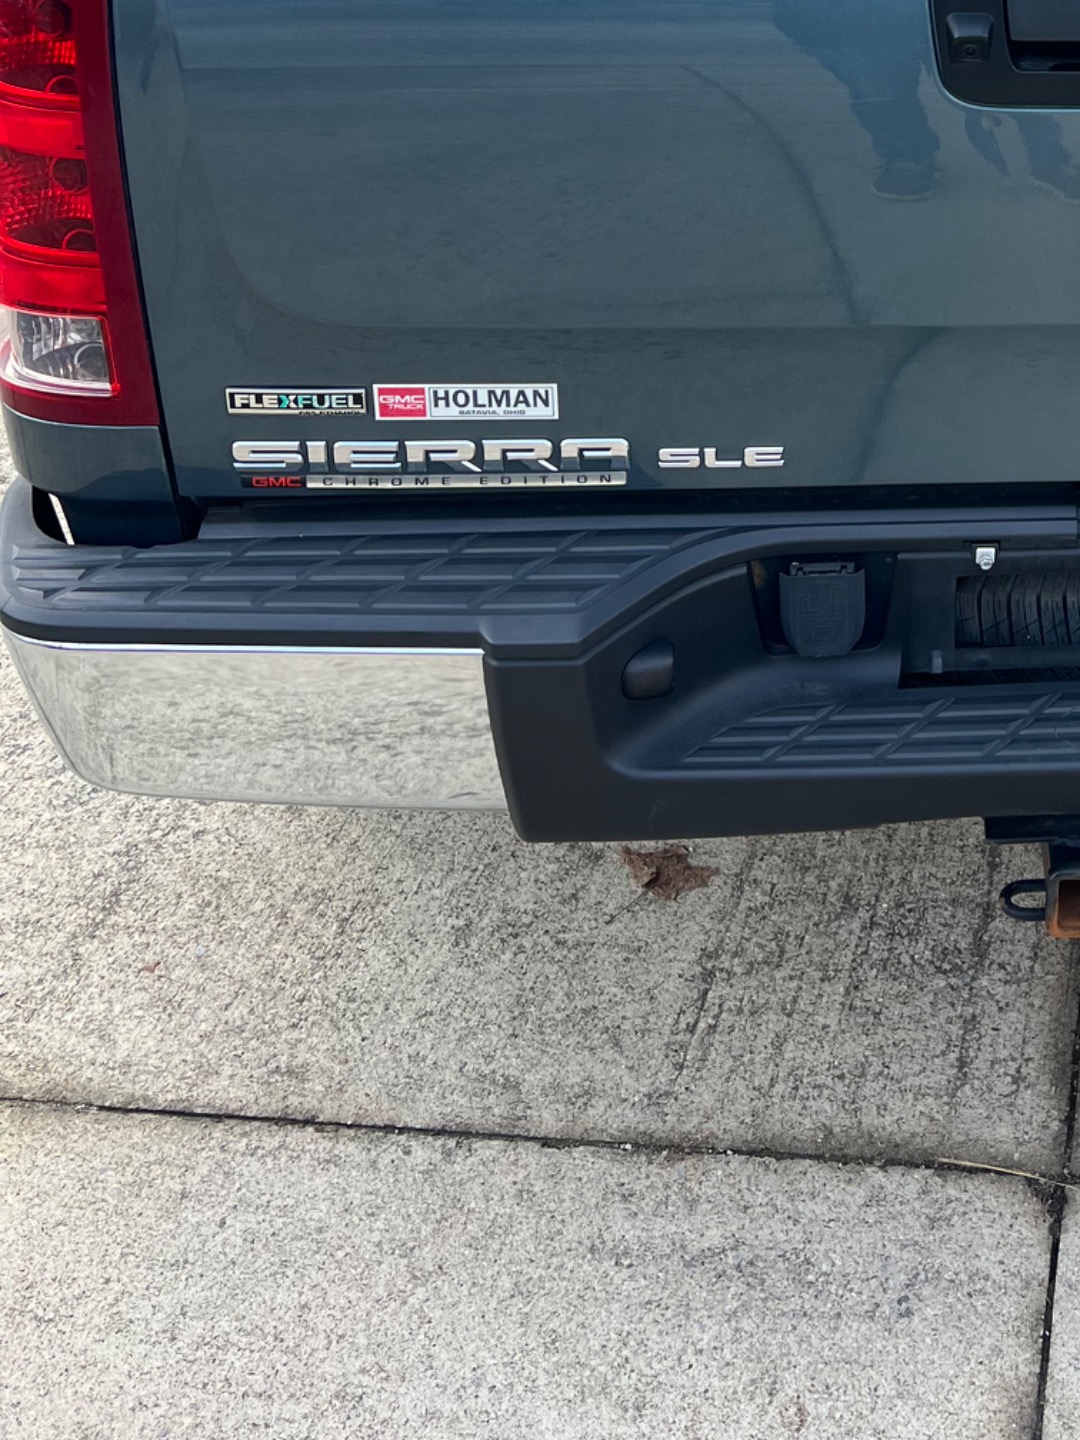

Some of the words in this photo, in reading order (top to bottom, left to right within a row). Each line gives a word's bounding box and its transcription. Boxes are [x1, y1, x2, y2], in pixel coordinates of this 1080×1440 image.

[234, 394, 362, 409] FLEXFUEL
[379, 395, 425, 404] GMC
[432, 389, 550, 408] HOLMAN
[232, 438, 631, 473] SIERRA
[658, 446, 785, 468] SLE
[252, 476, 303, 488] GMC
[322, 476, 451, 487] CHROME
[479, 474, 613, 486] EDITION
